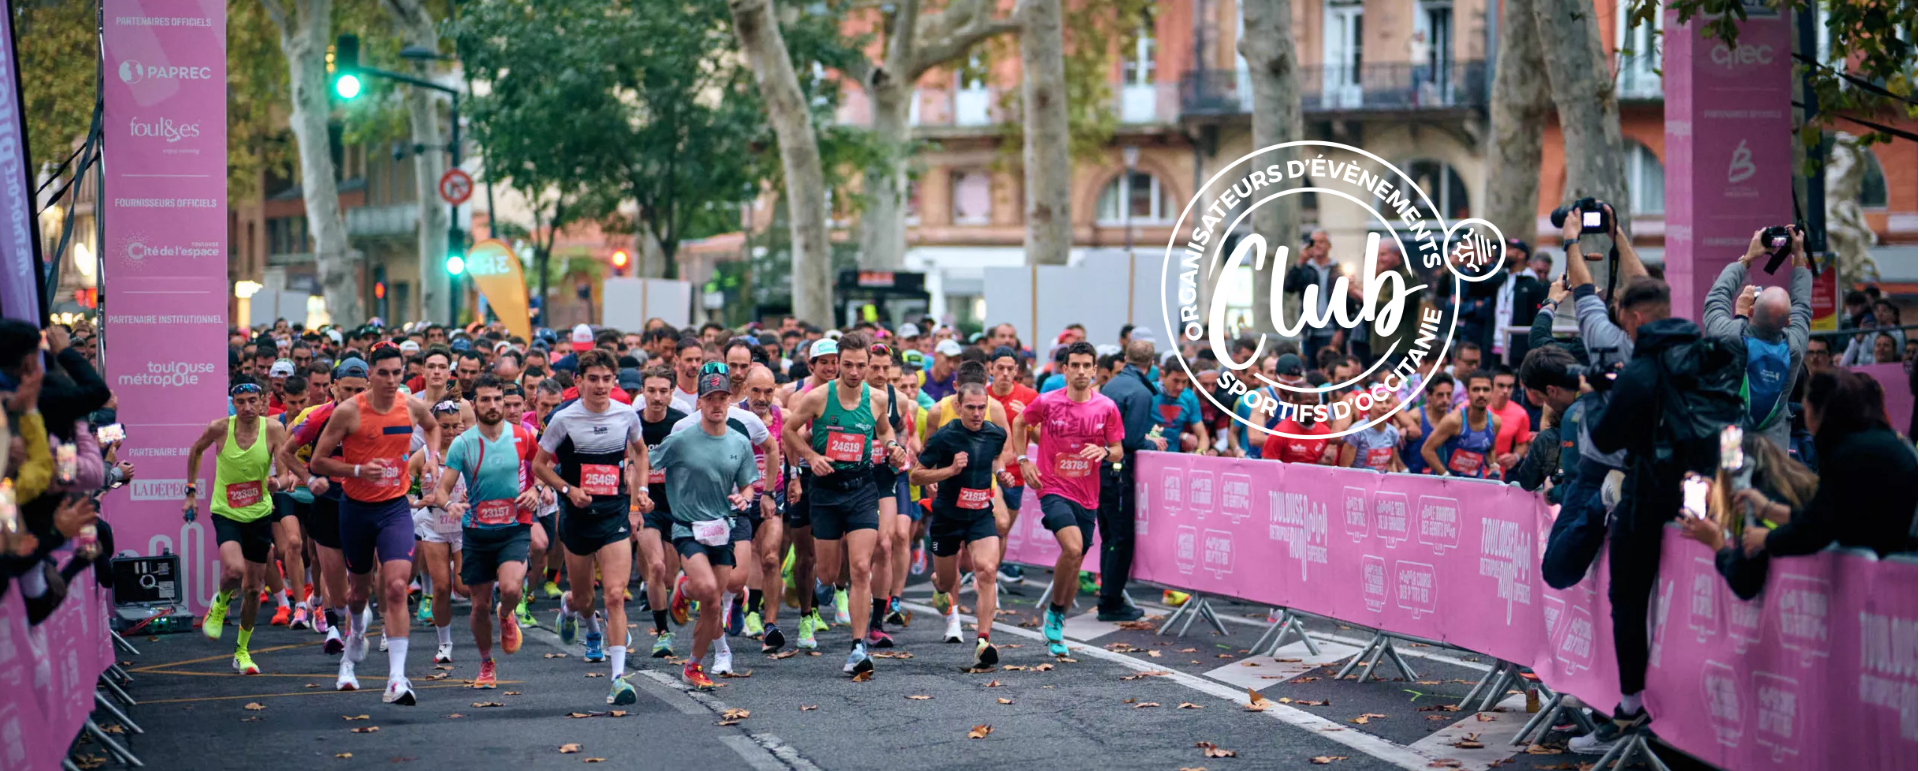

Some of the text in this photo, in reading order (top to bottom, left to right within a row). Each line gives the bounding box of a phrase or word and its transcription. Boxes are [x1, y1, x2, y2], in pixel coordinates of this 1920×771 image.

[116, 17, 212, 27] PARTENAIRES OFFICIELS
[147, 66, 211, 79] PAPREC
[115, 198, 217, 208] FOURNISSEURS OFFICIELS
[108, 315, 223, 324] PARTENAIRE INSTITUTIONNEL
[118, 373, 199, 387] métropole
[129, 447, 177, 457] PARTENAIRE
[1060, 459, 1088, 470] 23784
[133, 483, 150, 497] LA
[1268, 490, 1303, 526] TOULOUSE
[1481, 517, 1513, 559] TOULOUSE
